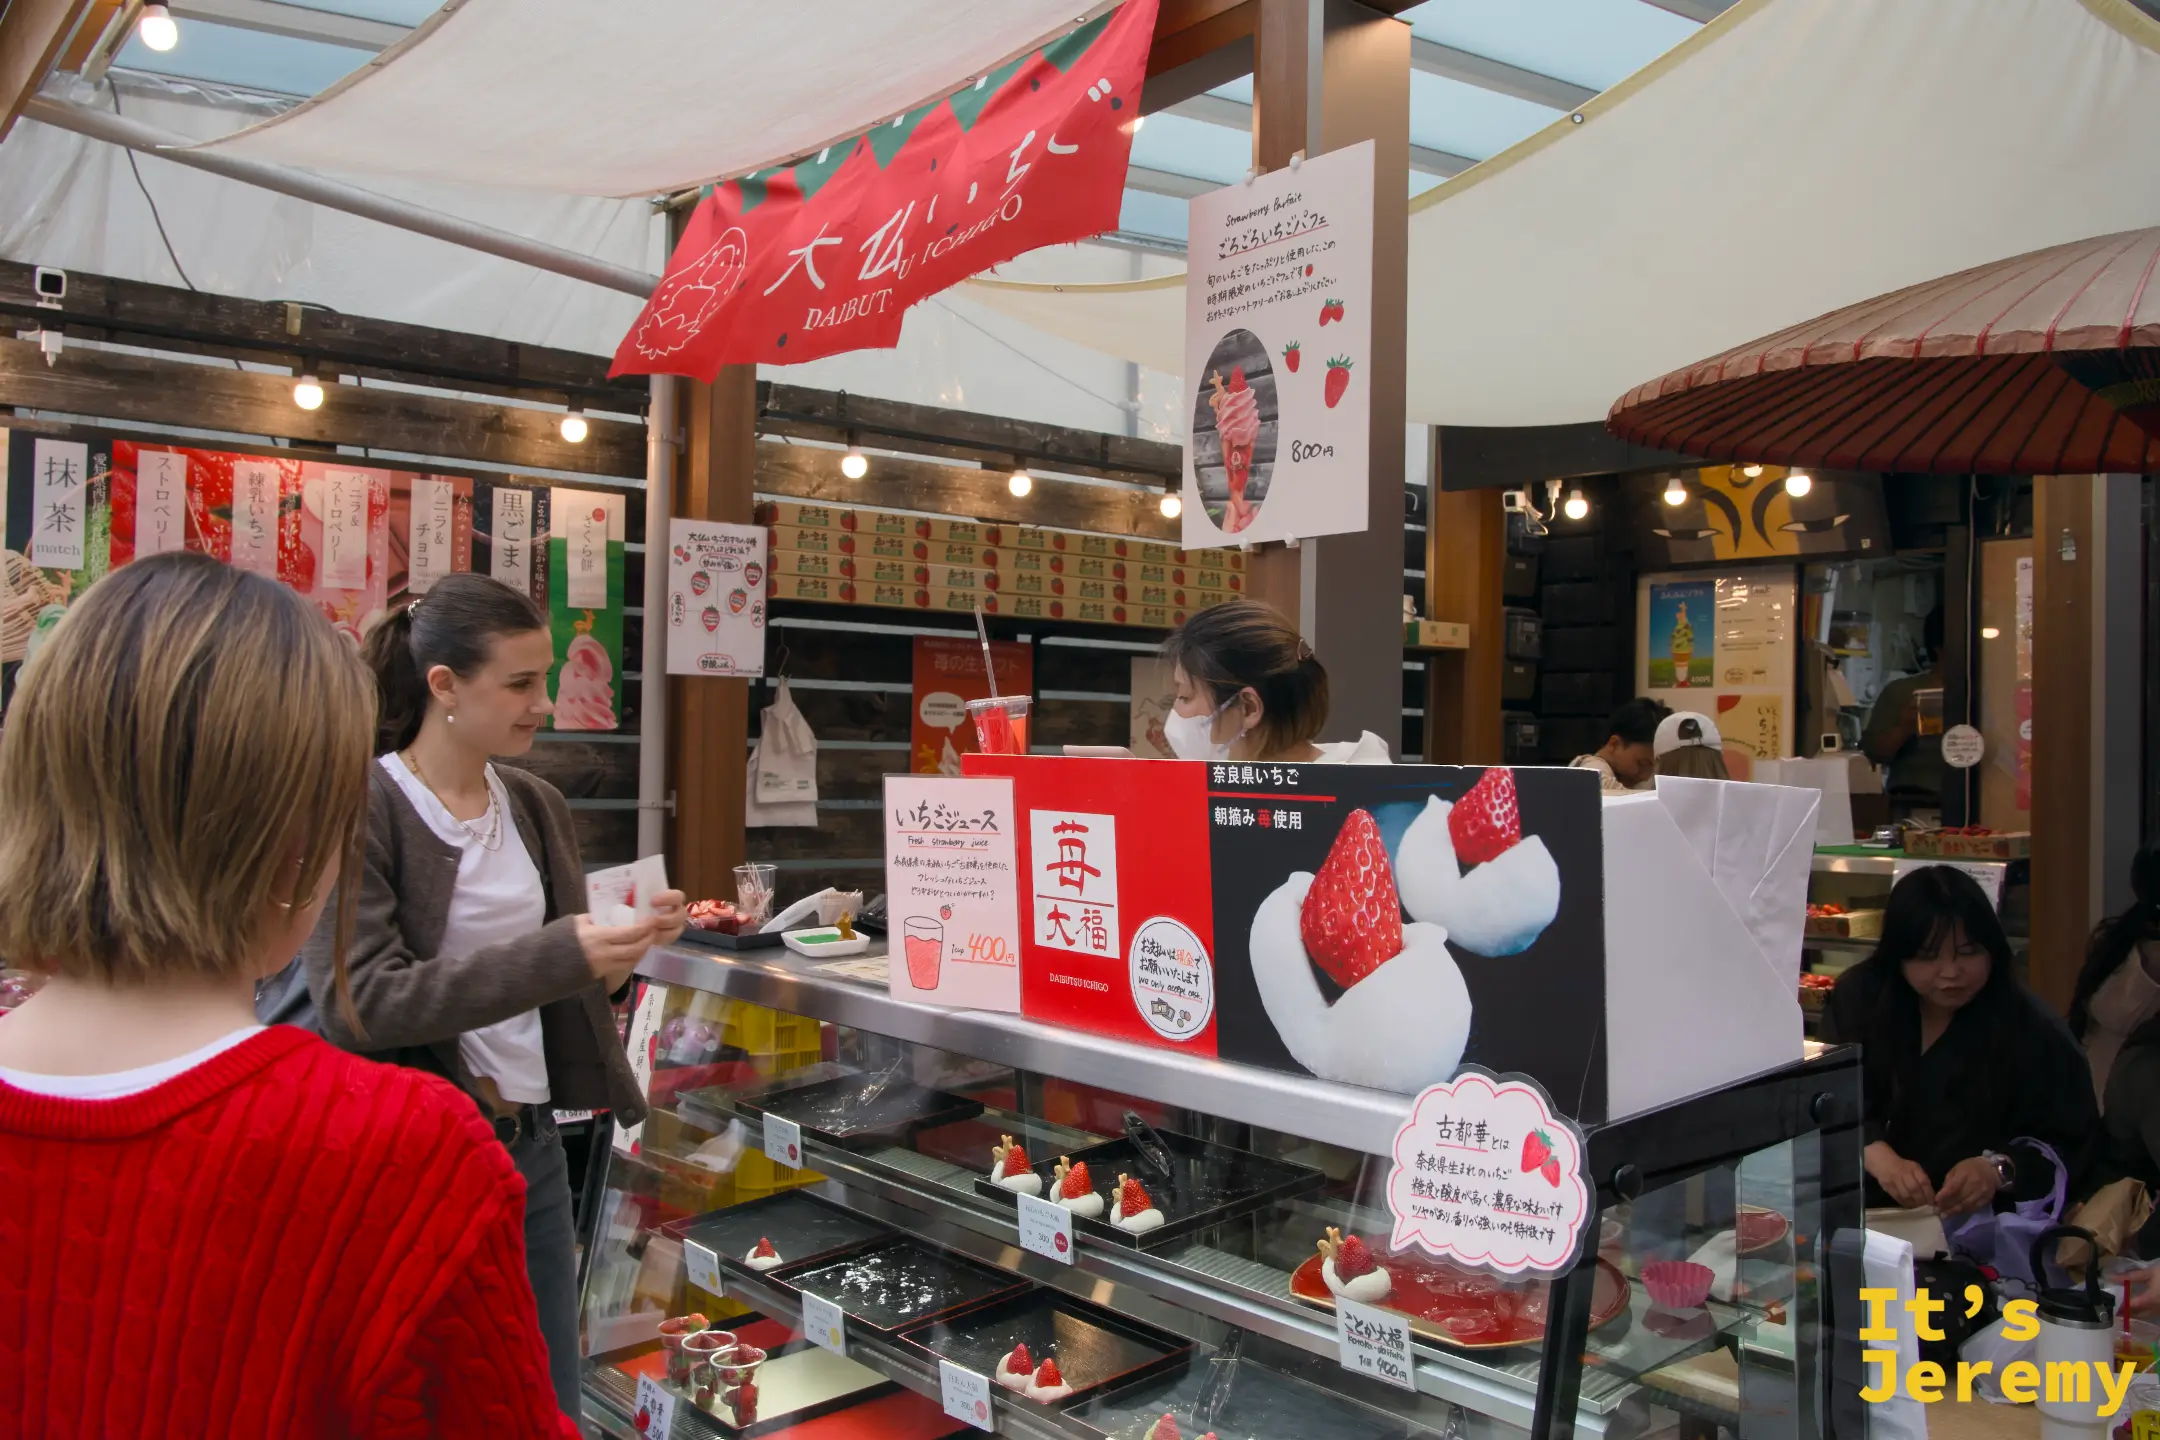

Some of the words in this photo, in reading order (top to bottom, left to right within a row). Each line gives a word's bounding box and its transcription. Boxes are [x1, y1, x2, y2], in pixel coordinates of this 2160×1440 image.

[1225, 203, 1270, 227] Strawberry
[1273, 191, 1303, 213] Parfait
[921, 193, 1023, 266] ICHIGO
[1291, 439, 1334, 463] 800円
[43, 455, 80, 534] 抹茶
[153, 456, 172, 549] ストロベリー
[248, 470, 266, 549] 練乳いちご
[328, 480, 344, 563] ストロベリー
[500, 491, 525, 569] 黒ごま
[415, 522, 430, 568] チョコ
[580, 514, 594, 573] さくら餅
[1212, 764, 1300, 786] 奈良県いちご
[895, 798, 999, 831] いちごジュース
[1213, 805, 1302, 830] 朝摘み苺使用
[907, 835, 925, 846] Fresh
[970, 838, 990, 849] juice
[1046, 820, 1102, 897] 苺
[1046, 903, 1108, 952] 大福
[967, 932, 1015, 963] 400円
[1141, 936, 1202, 970] お支払いは現金で
[1049, 972, 1082, 989] DAIBUTSU
[1083, 976, 1109, 993] ICHIGO
[1139, 956, 1200, 987] お願いいたします
[1435, 1113, 1511, 1151] 古都華とは
[1415, 1150, 1512, 1181] 奈良県生まれのいちご
[1376, 1356, 1408, 1382] 400円
